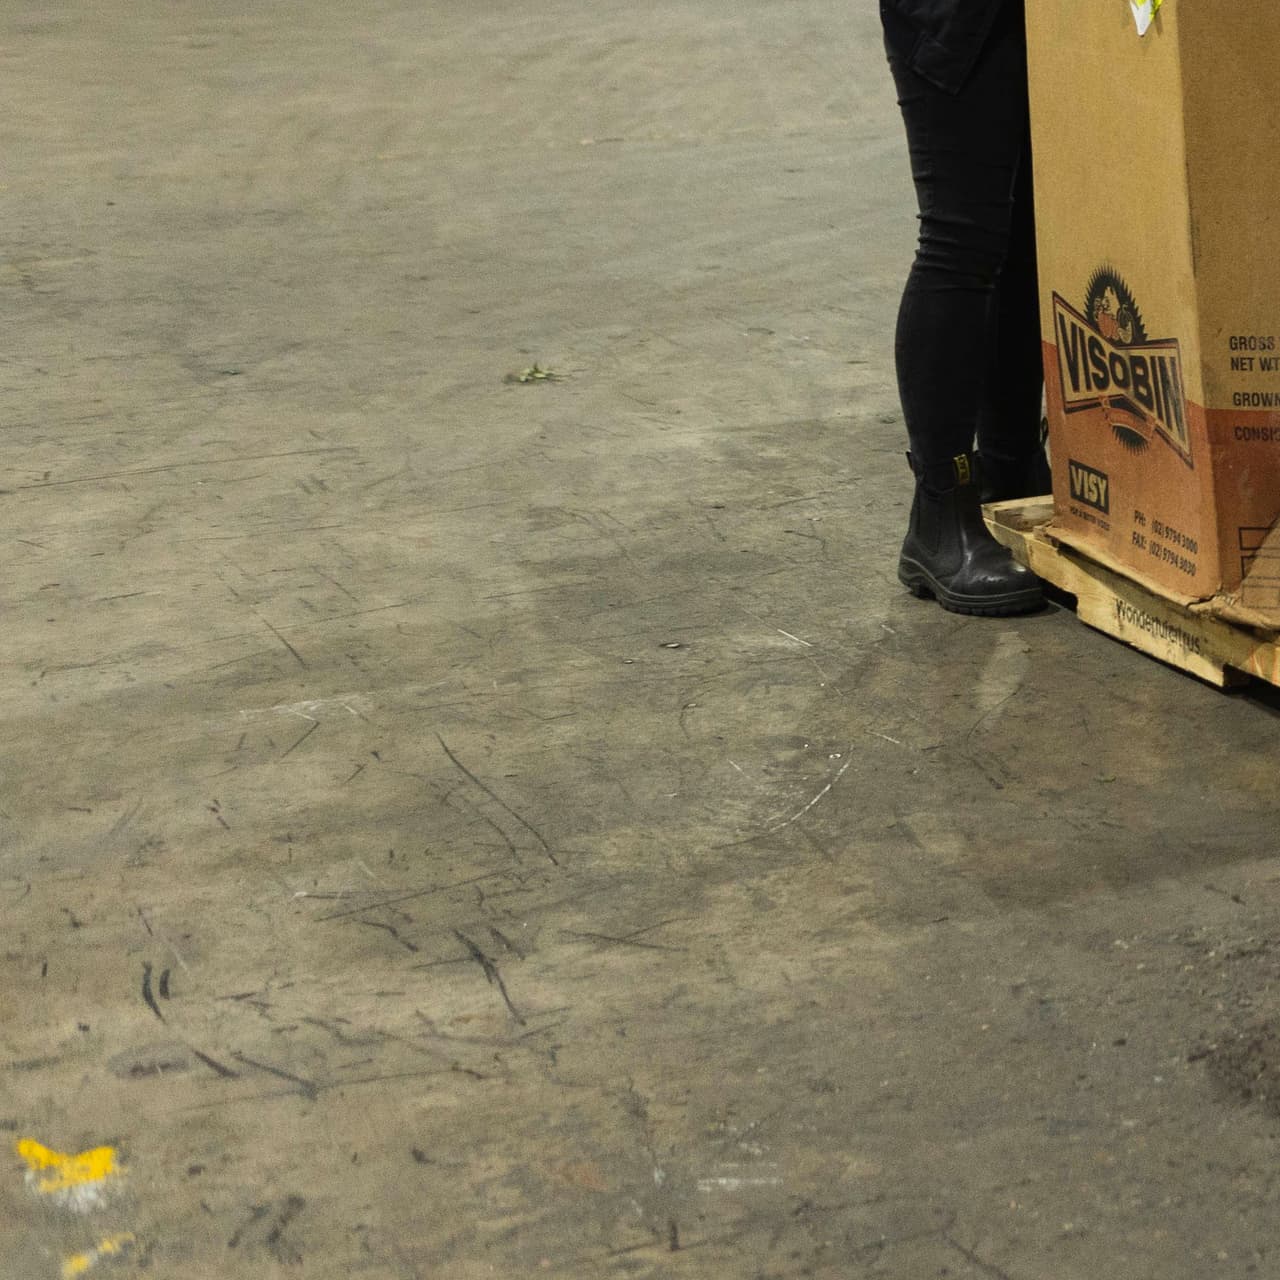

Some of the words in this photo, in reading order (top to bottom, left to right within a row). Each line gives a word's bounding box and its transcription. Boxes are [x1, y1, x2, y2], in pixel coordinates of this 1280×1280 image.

[1229, 336, 1275, 351] GROSS
[1058, 312, 1187, 443] VISOBIN
[1231, 357, 1255, 372] NET
[1260, 357, 1280, 372] WT
[1071, 465, 1108, 508] VISY
[1132, 532, 1147, 550] FAX:
[1149, 540, 1163, 561] (02)
[1163, 547, 1179, 567] 9794
[1134, 510, 1146, 527] PH:
[1151, 519, 1165, 538] (02)
[1165, 526, 1181, 545] 9794
[1181, 534, 1198, 555] 3000
